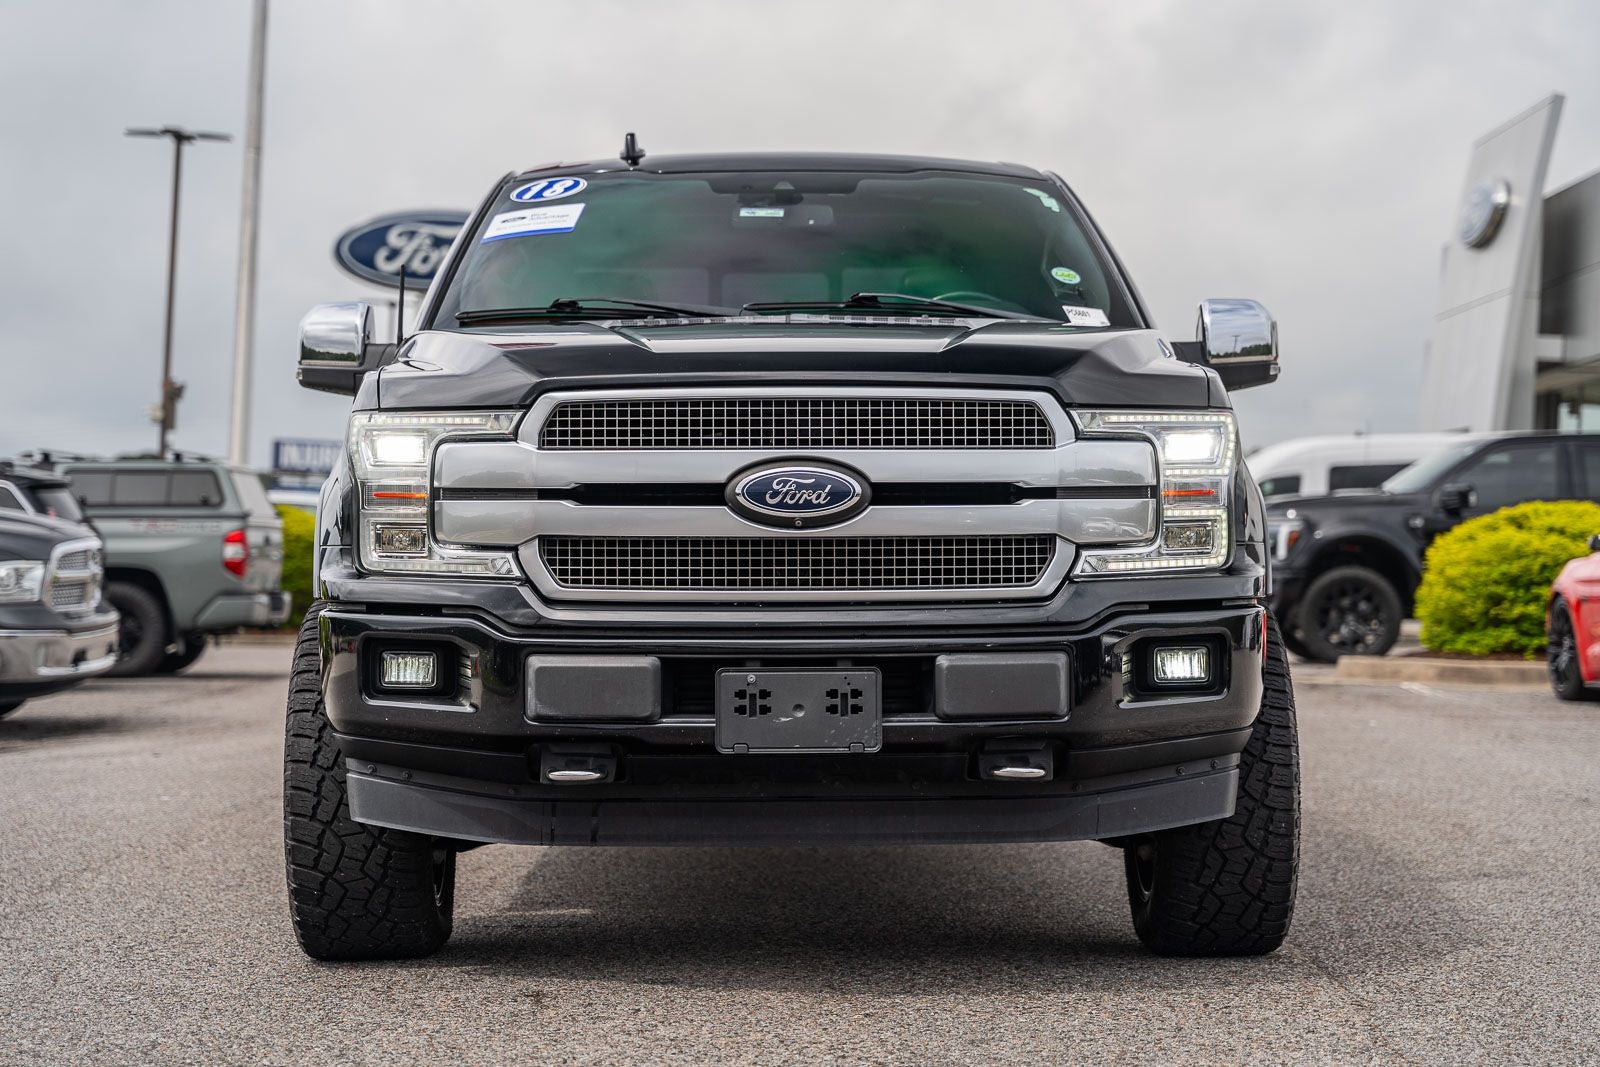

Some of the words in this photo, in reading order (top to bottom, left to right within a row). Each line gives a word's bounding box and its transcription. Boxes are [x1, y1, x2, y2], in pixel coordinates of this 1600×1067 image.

[521, 179, 575, 200] 18
[374, 223, 463, 276] Fo
[765, 477, 832, 505] Ford
